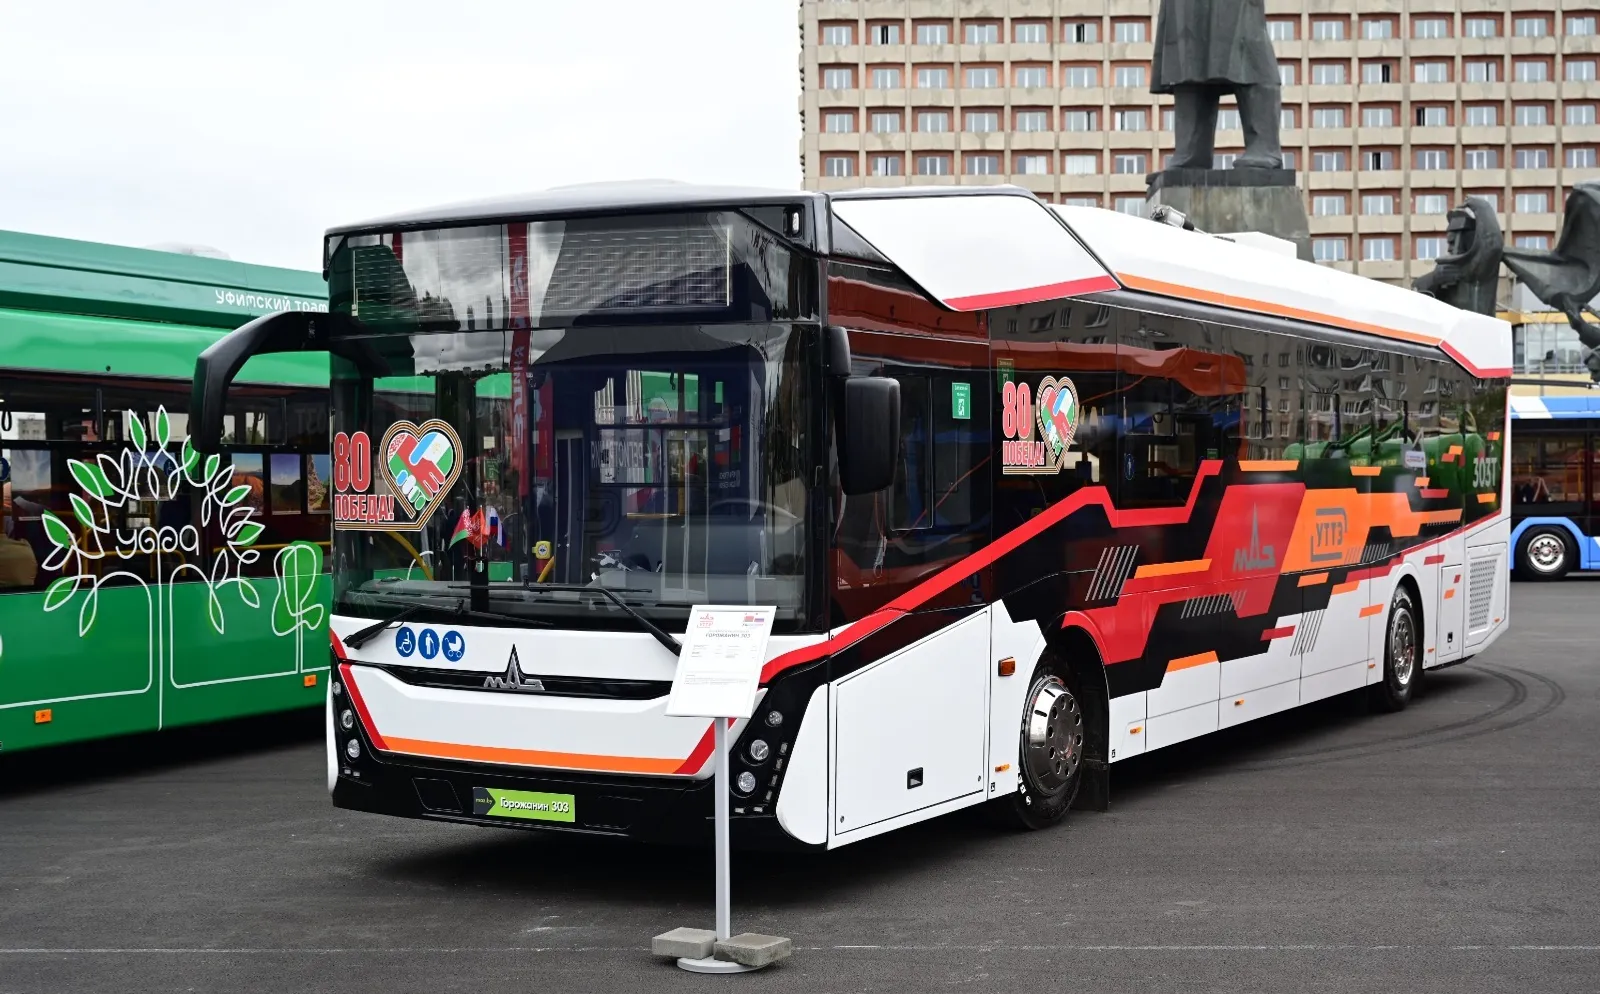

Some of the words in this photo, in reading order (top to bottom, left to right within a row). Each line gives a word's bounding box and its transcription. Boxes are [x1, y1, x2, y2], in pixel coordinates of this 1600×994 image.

[1003, 381, 1031, 439] 80
[334, 431, 371, 492] 80
[1003, 440, 1045, 468] ПОБЕДА!
[334, 494, 395, 524] ПОБЕДА!
[500, 796, 550, 812] Горожанин
[551, 801, 570, 813] 303
